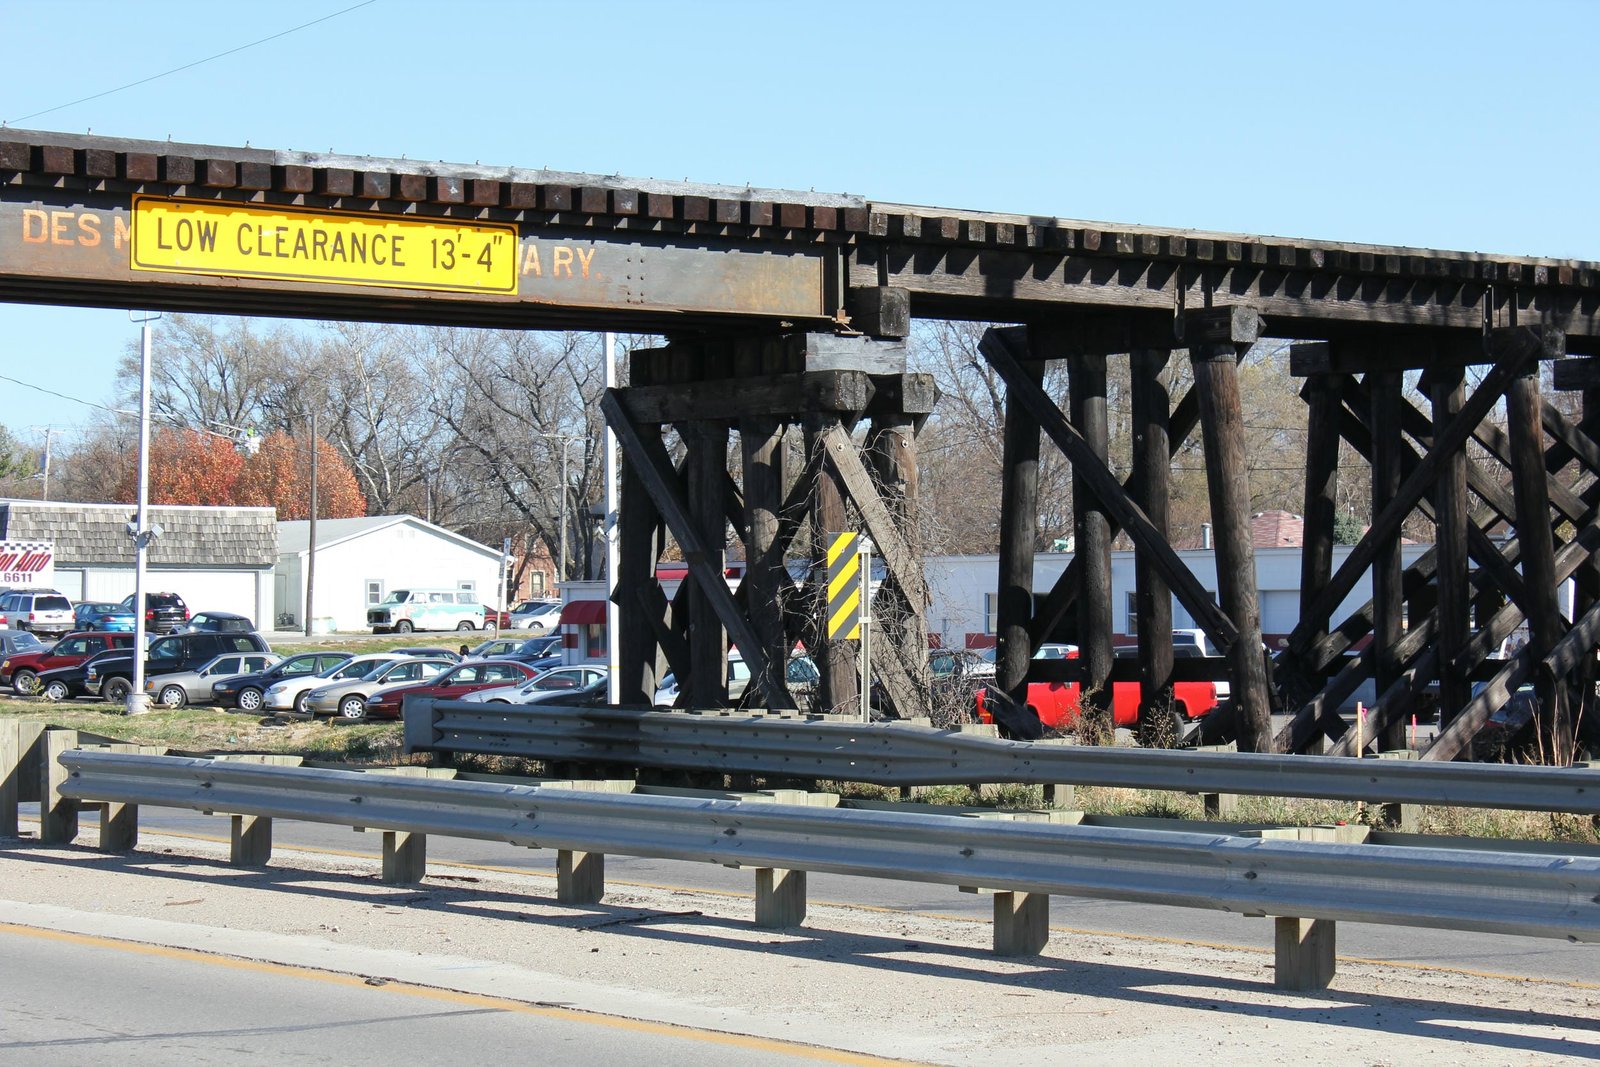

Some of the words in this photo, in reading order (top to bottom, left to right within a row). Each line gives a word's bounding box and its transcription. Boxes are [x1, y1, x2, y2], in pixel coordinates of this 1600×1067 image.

[22, 208, 101, 247] DES
[157, 216, 218, 253] LOW
[237, 222, 406, 267] CLEARANCE
[431, 233, 503, 273] 13'-4"
[11, 550, 52, 572] Auto
